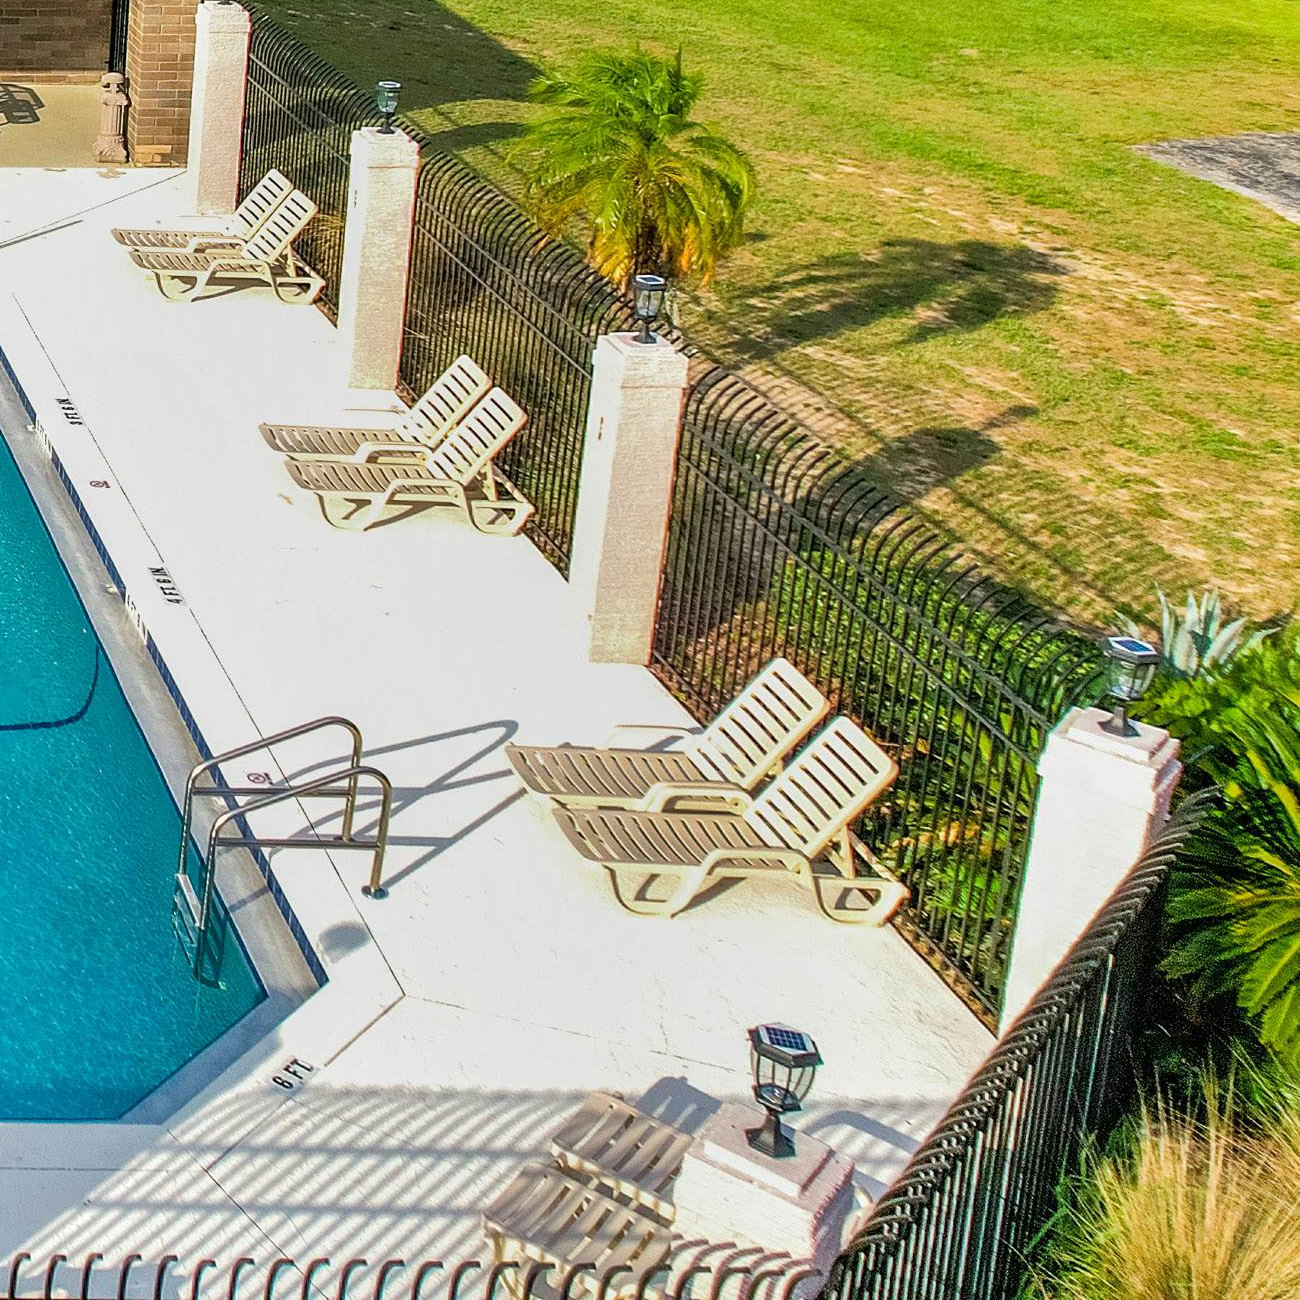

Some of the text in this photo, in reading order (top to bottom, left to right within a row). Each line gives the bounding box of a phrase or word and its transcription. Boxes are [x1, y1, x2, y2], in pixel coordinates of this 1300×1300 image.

[148, 566, 168, 576] IN
[160, 586, 179, 596] FT
[272, 1058, 313, 1089] 6 FT
